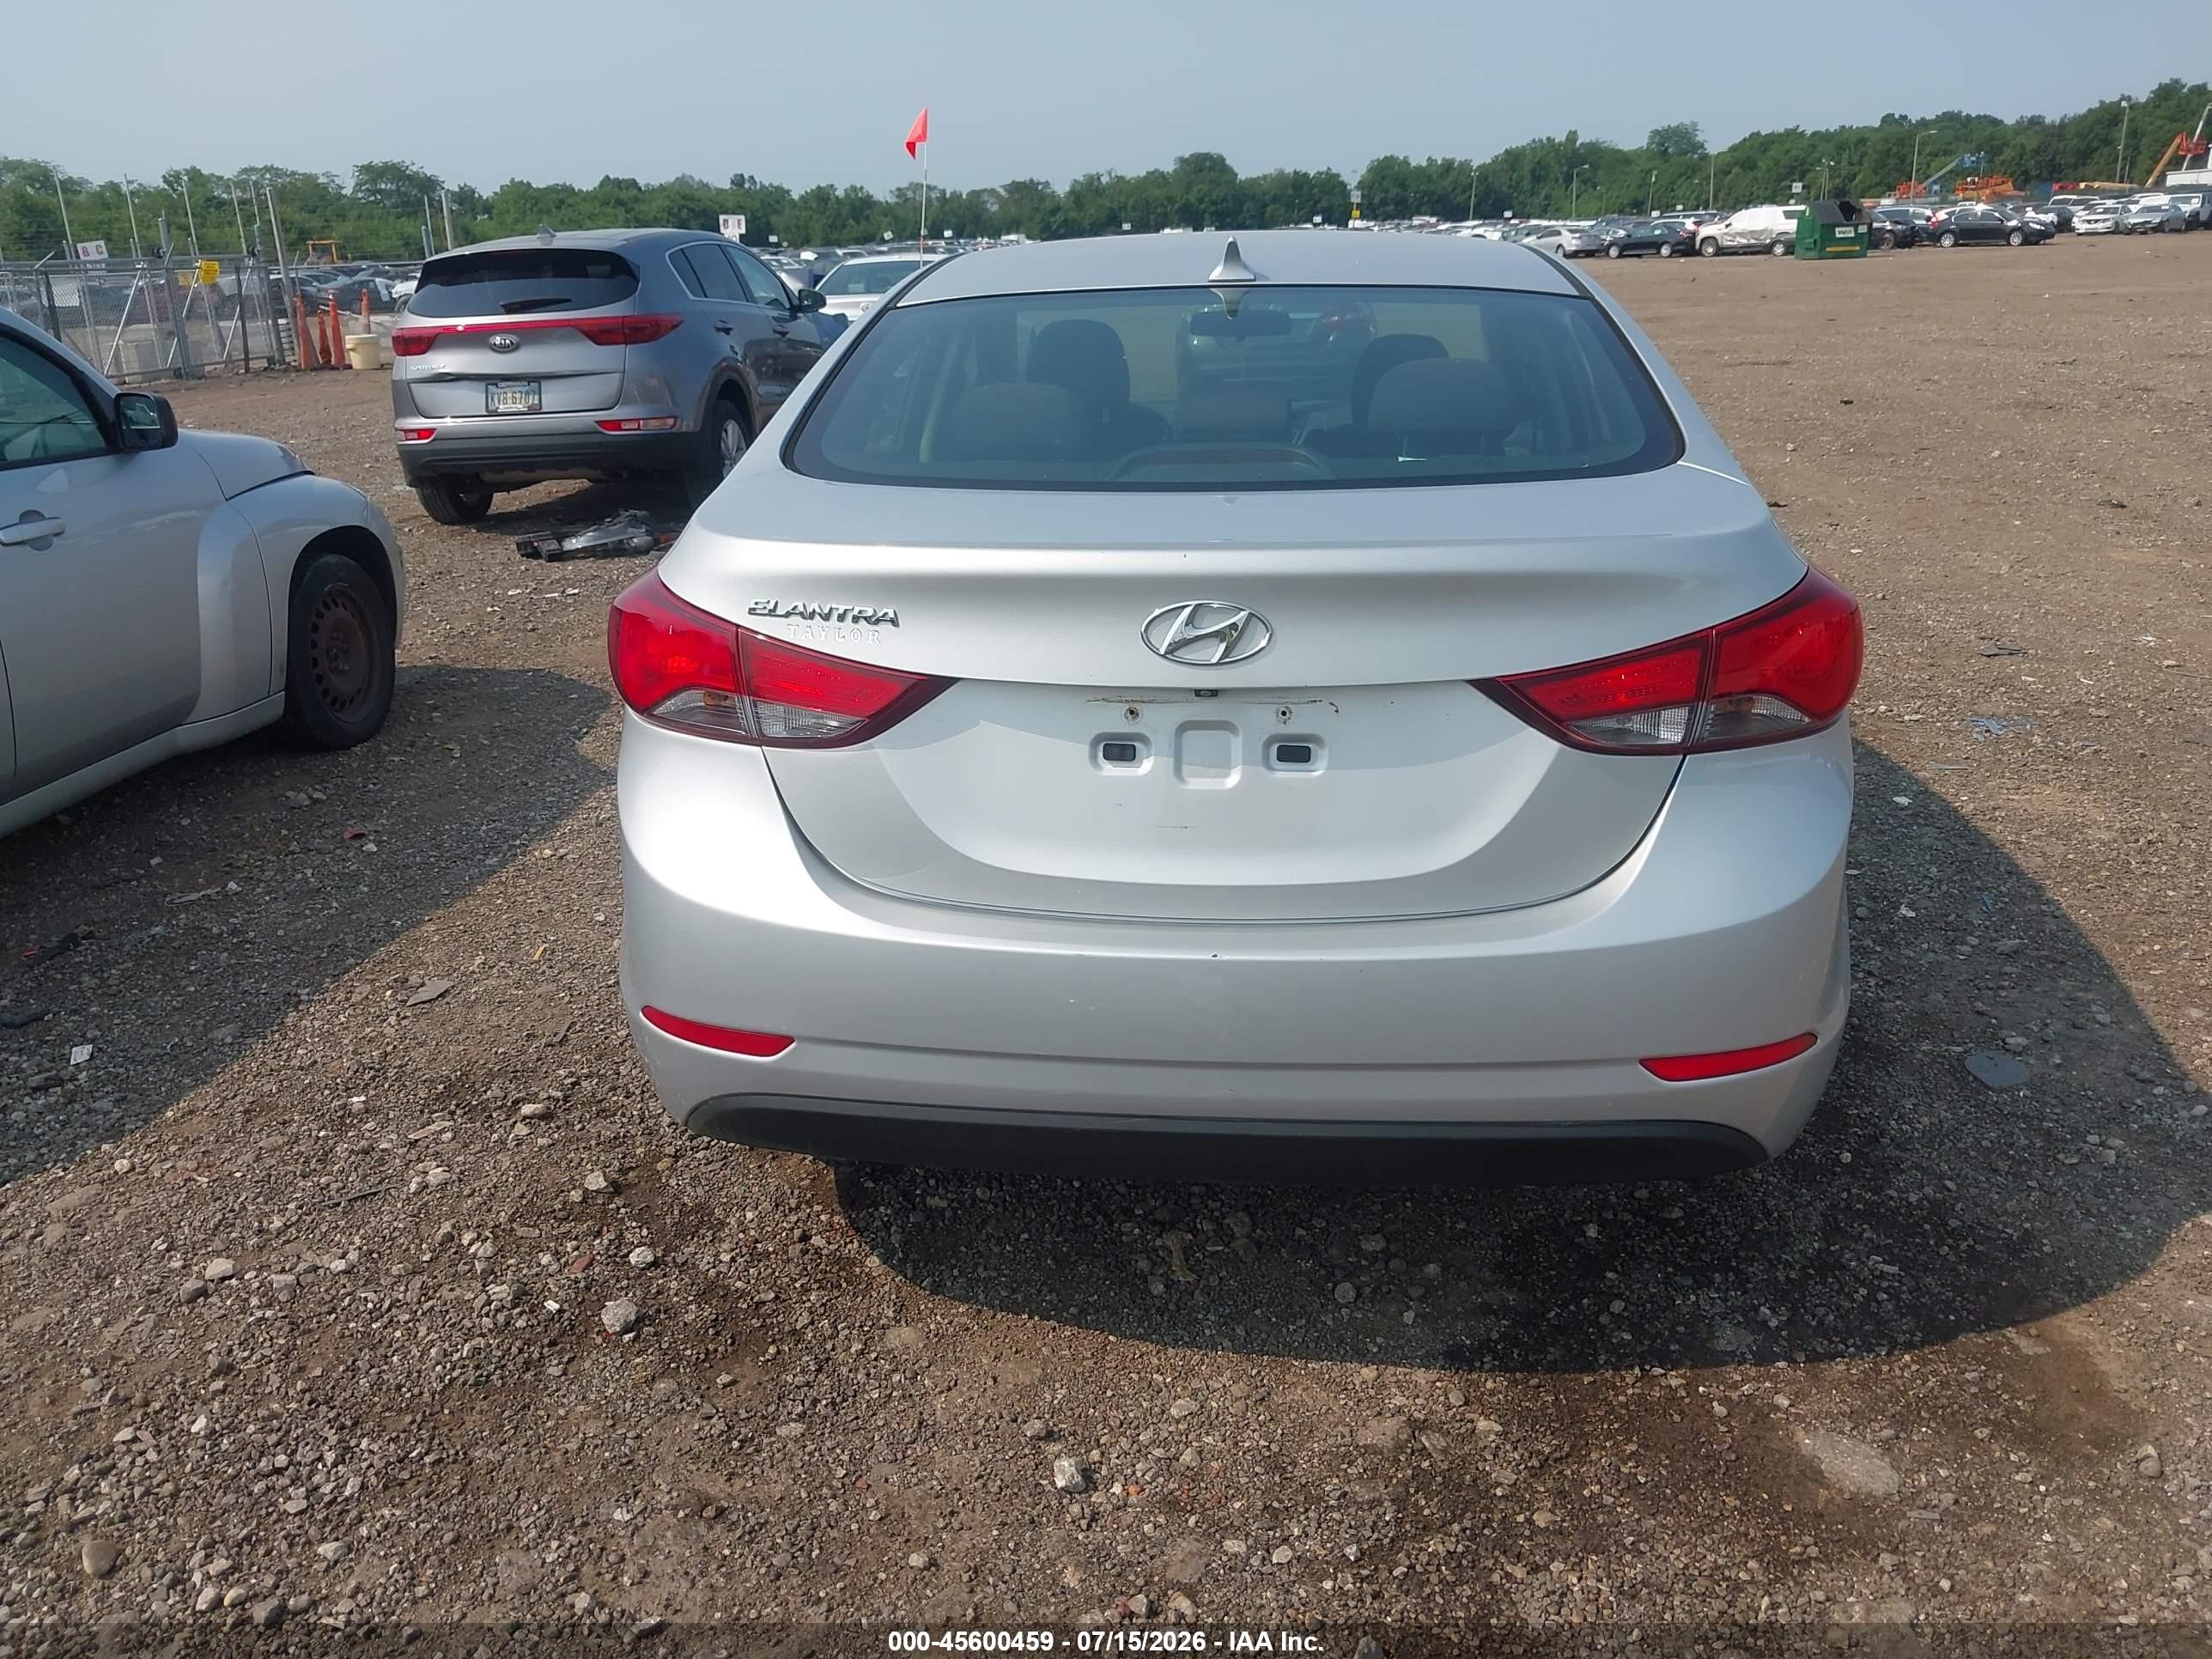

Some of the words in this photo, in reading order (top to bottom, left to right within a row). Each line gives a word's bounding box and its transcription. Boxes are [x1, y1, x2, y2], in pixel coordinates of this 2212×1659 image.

[82, 246, 90, 258] B
[95, 244, 104, 255] C
[511, 390, 536, 405] 6707
[748, 599, 900, 628] ELANTRA
[787, 623, 881, 644] TAYLOR
